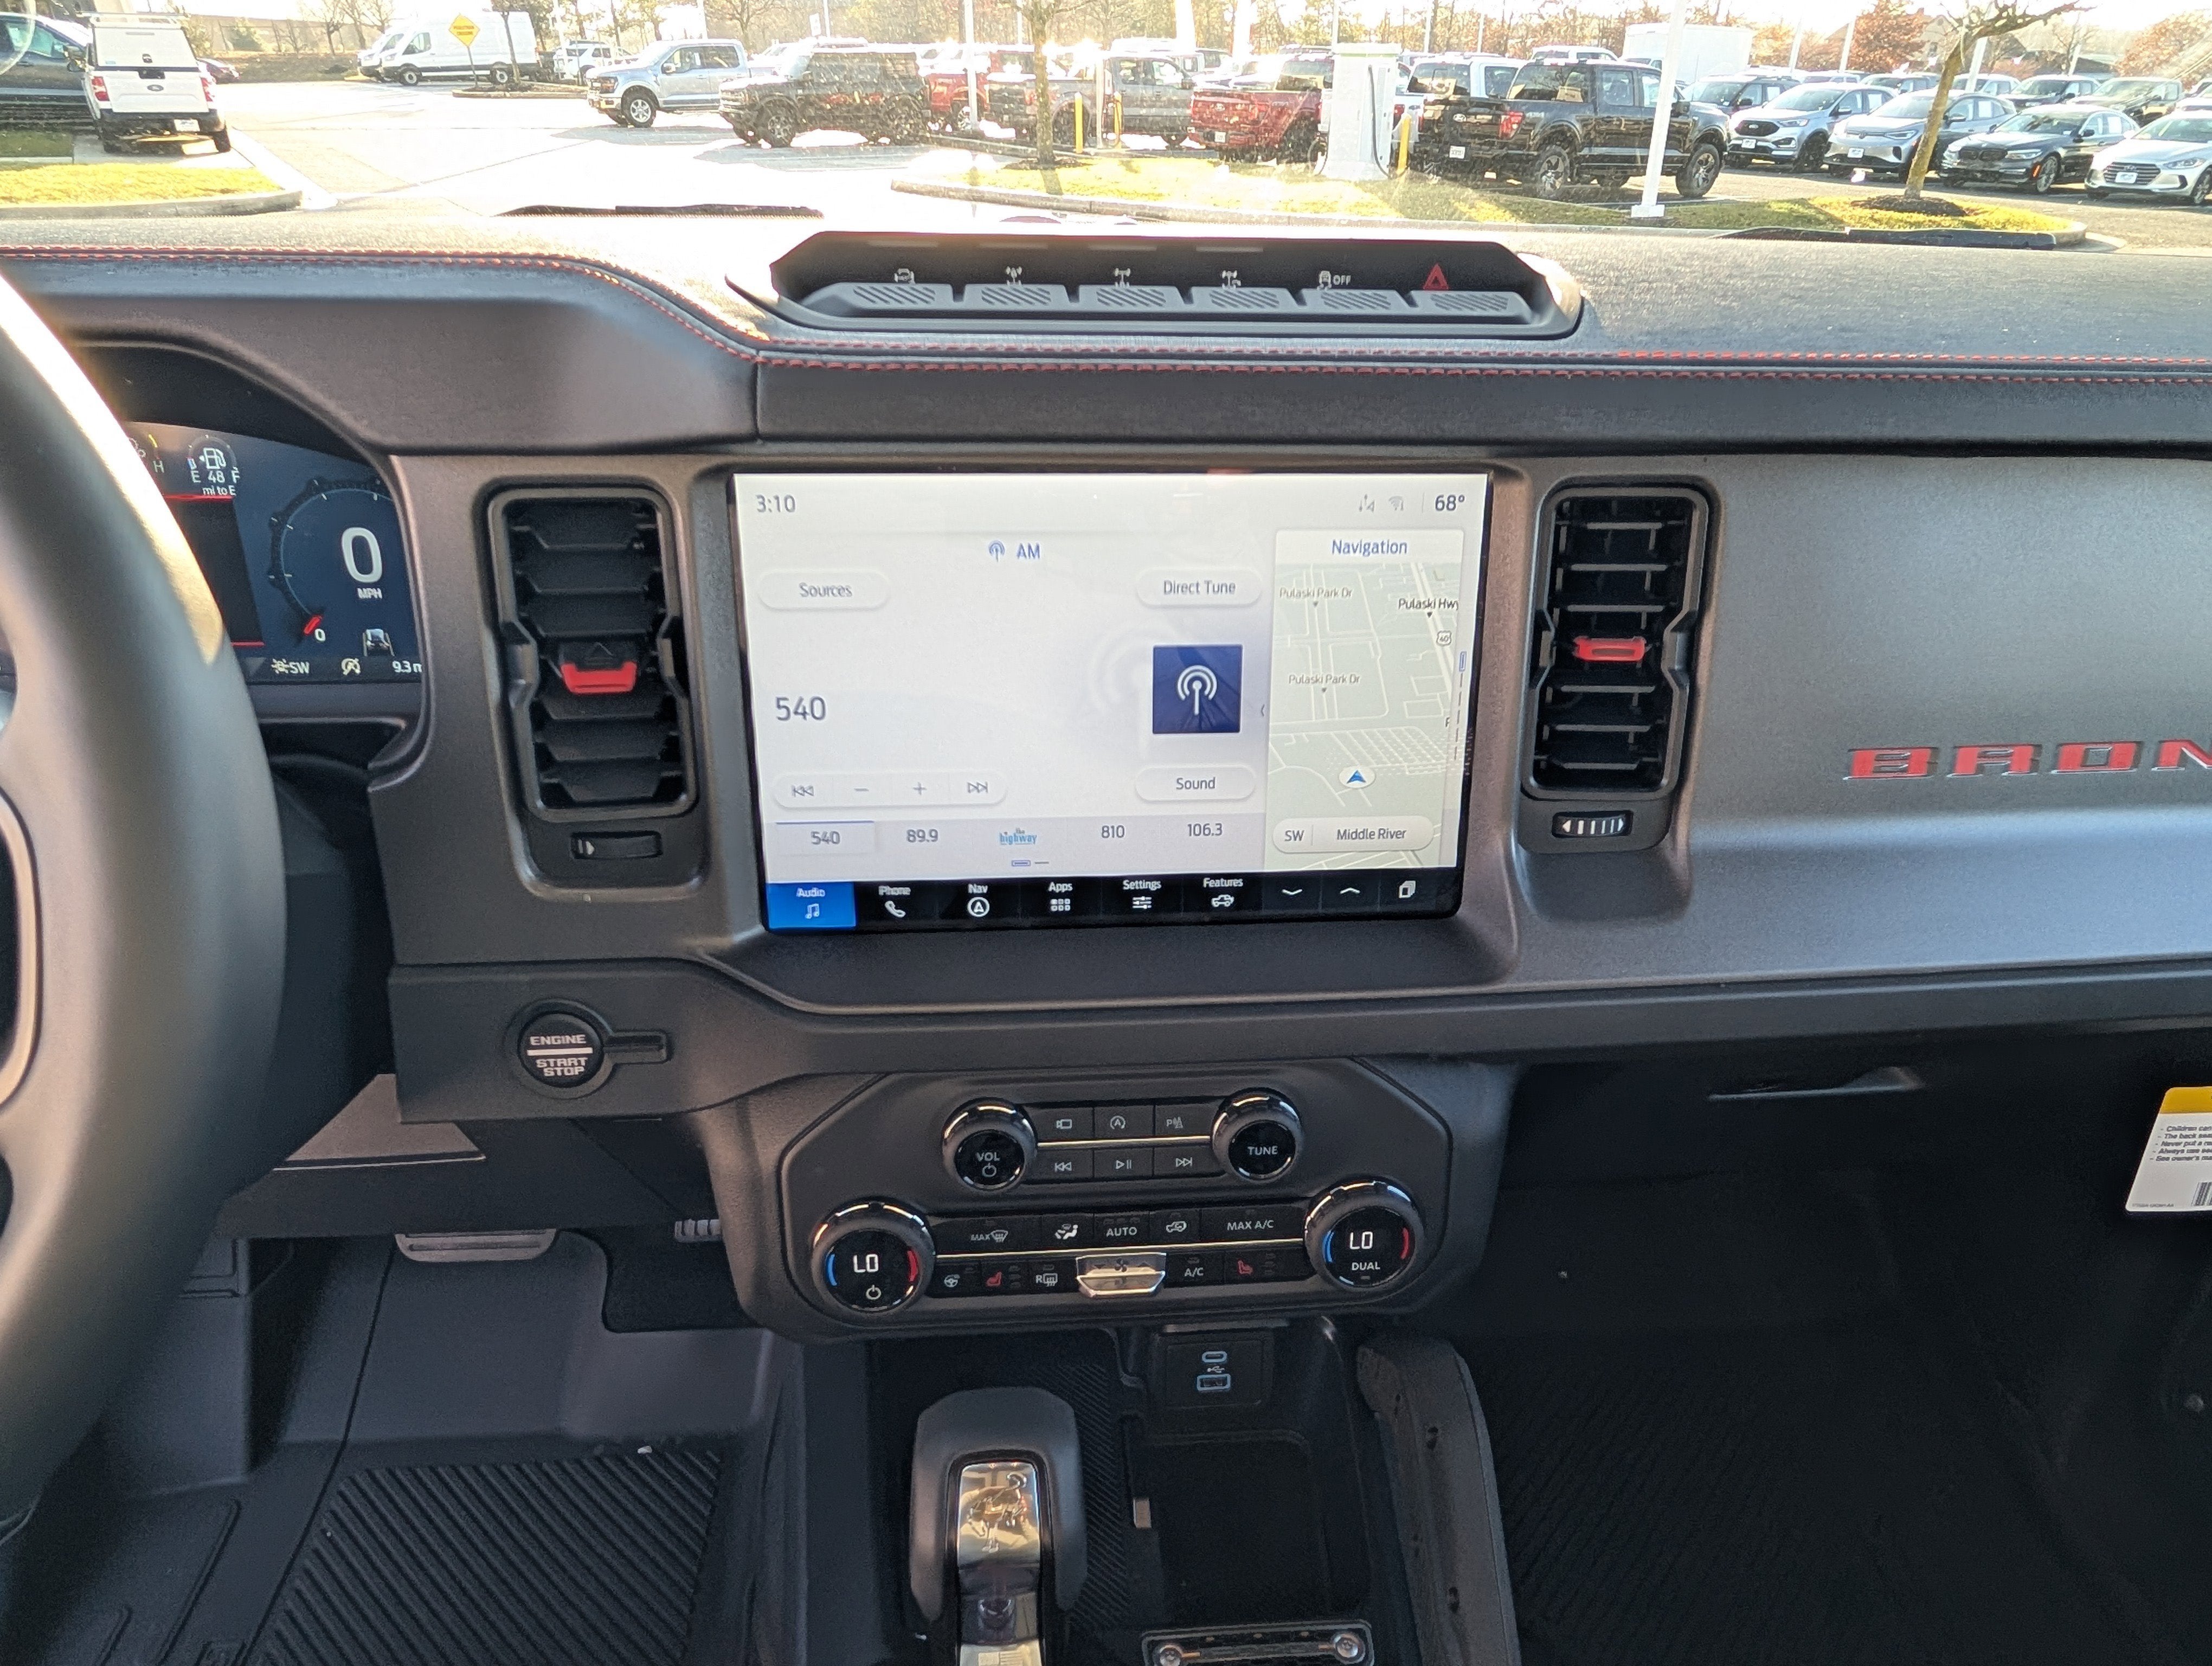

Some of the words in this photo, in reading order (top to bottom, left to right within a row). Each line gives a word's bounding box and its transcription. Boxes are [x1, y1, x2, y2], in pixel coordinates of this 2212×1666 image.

[1333, 274, 1352, 285] OFF
[153, 460, 165, 473] H
[190, 470, 201, 483] E
[208, 470, 225, 483] 48
[231, 470, 240, 484] F
[217, 485, 228, 496] to
[228, 485, 236, 496] E
[756, 495, 796, 513] 3:10
[1435, 494, 1465, 512] 68°
[1016, 543, 1041, 560] AM
[1332, 539, 1408, 556] Navigation
[342, 526, 382, 584] 0
[799, 582, 852, 597] Sources
[1163, 580, 1200, 594] Direct
[1204, 580, 1236, 594] Tune
[1279, 587, 1315, 599] Pulaski
[1317, 587, 1339, 597] Park
[1341, 587, 1353, 597] Dr
[357, 588, 383, 599] MPH
[1399, 598, 1436, 610] Pulaski
[314, 628, 326, 642] 0
[1289, 674, 1323, 684] Pulaski
[1326, 674, 1347, 683] Park
[1349, 674, 1360, 683] Dr
[776, 696, 827, 721] 540
[1176, 776, 1216, 790] Sound
[906, 829, 938, 843] 89.9
[1101, 824, 1125, 838] 810
[1187, 823, 1223, 837] 106.3
[1284, 829, 1304, 842] SW
[1336, 828, 1375, 841] Middle
[1378, 827, 1407, 840] River
[811, 831, 841, 844] 540
[999, 832, 1037, 845] highway
[968, 883, 988, 893] Nav
[1048, 882, 1073, 893] Apps
[1123, 879, 1162, 891] Settings
[1203, 877, 1243, 888] Features
[796, 887, 826, 898] Audio
[878, 885, 911, 895] Phone
[529, 1034, 587, 1046] ENGINE
[536, 1057, 588, 1068] START
[543, 1066, 586, 1077] STOP
[976, 1151, 1001, 1162] VOL
[1248, 1145, 1278, 1156] TUNE
[1227, 1220, 1252, 1231] MAX
[1254, 1219, 1274, 1230] A/C
[970, 1233, 991, 1242] MAX
[1106, 1226, 1137, 1237] AUTO
[1349, 1231, 1373, 1250] LO
[853, 1254, 879, 1273] LO
[1351, 1261, 1380, 1271] DUAL
[1184, 1267, 1204, 1277] A/C
